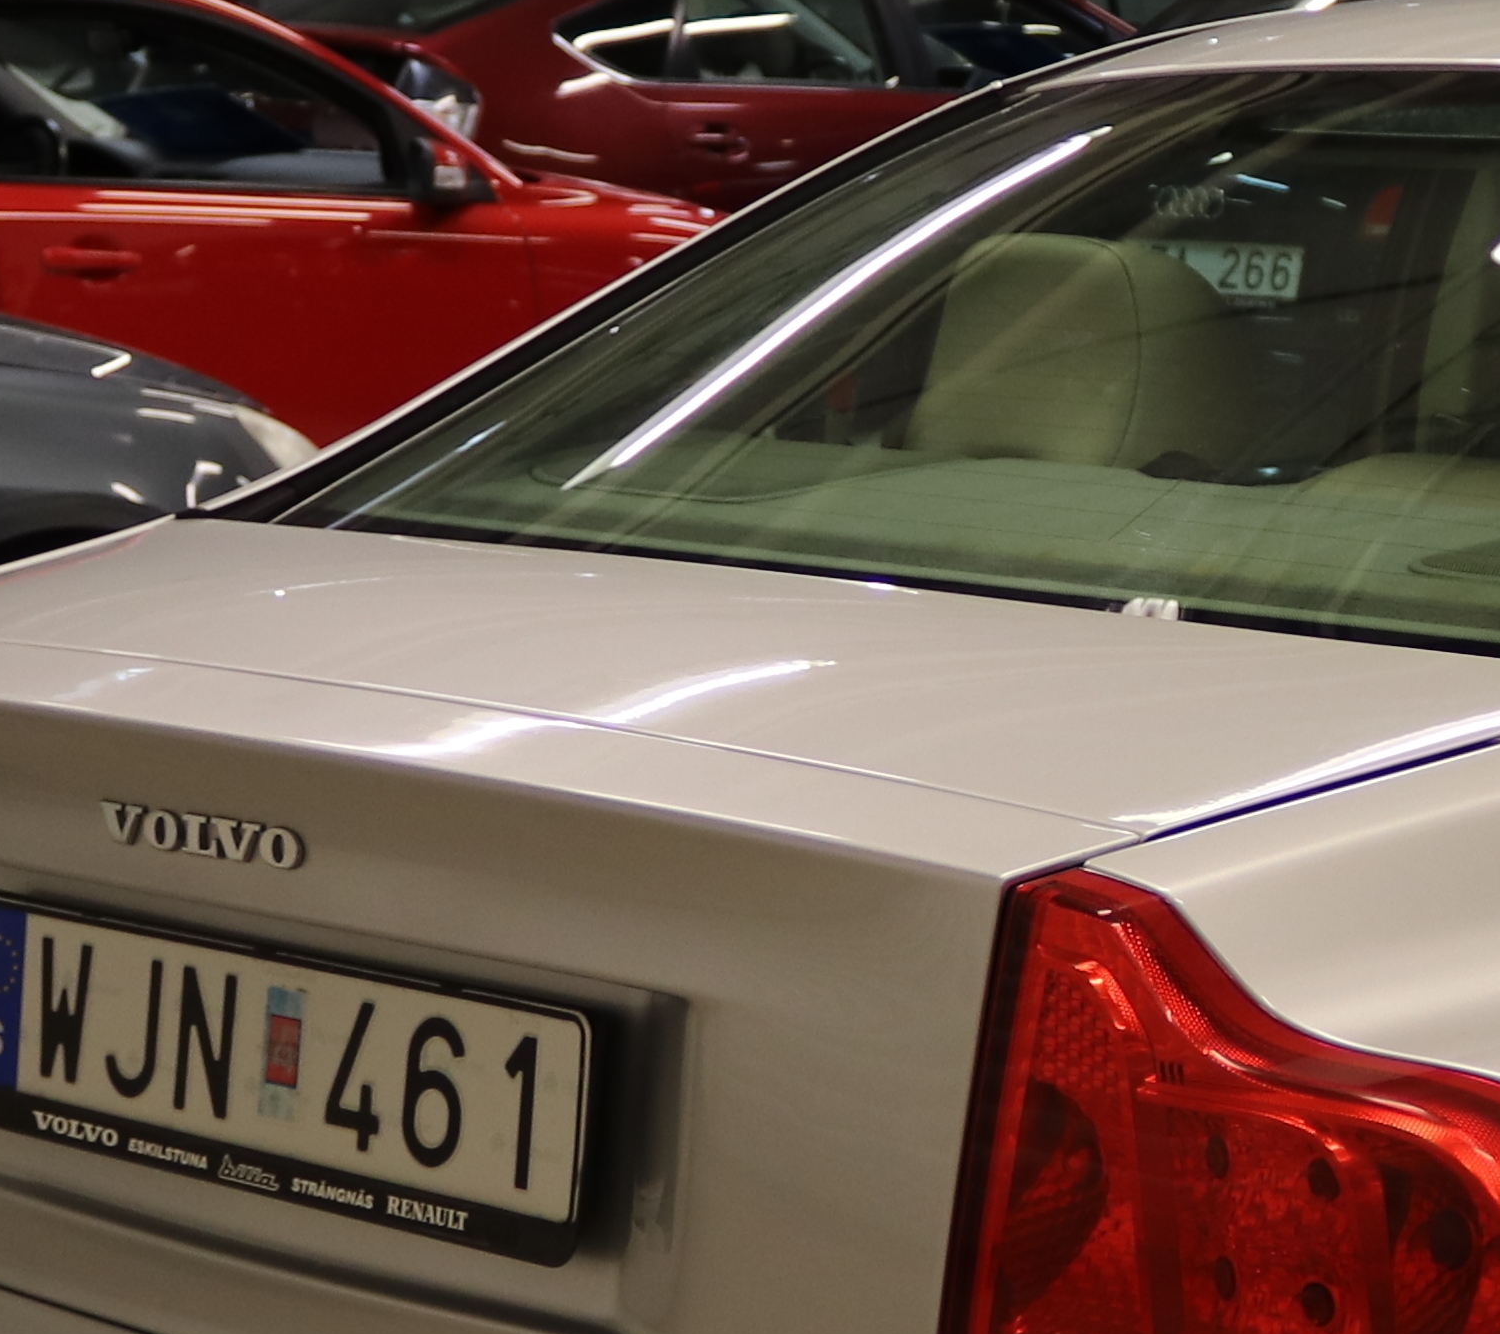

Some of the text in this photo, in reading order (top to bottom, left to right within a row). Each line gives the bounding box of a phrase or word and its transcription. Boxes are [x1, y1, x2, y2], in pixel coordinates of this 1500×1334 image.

[1219, 246, 1292, 291] 266
[100, 799, 305, 870] VOLVO
[40, 936, 538, 1191] WJN 461
[32, 1110, 120, 1148] VOLVO
[127, 1137, 208, 1170] ESKILSTUNA
[386, 1195, 470, 1231] RENAULT
